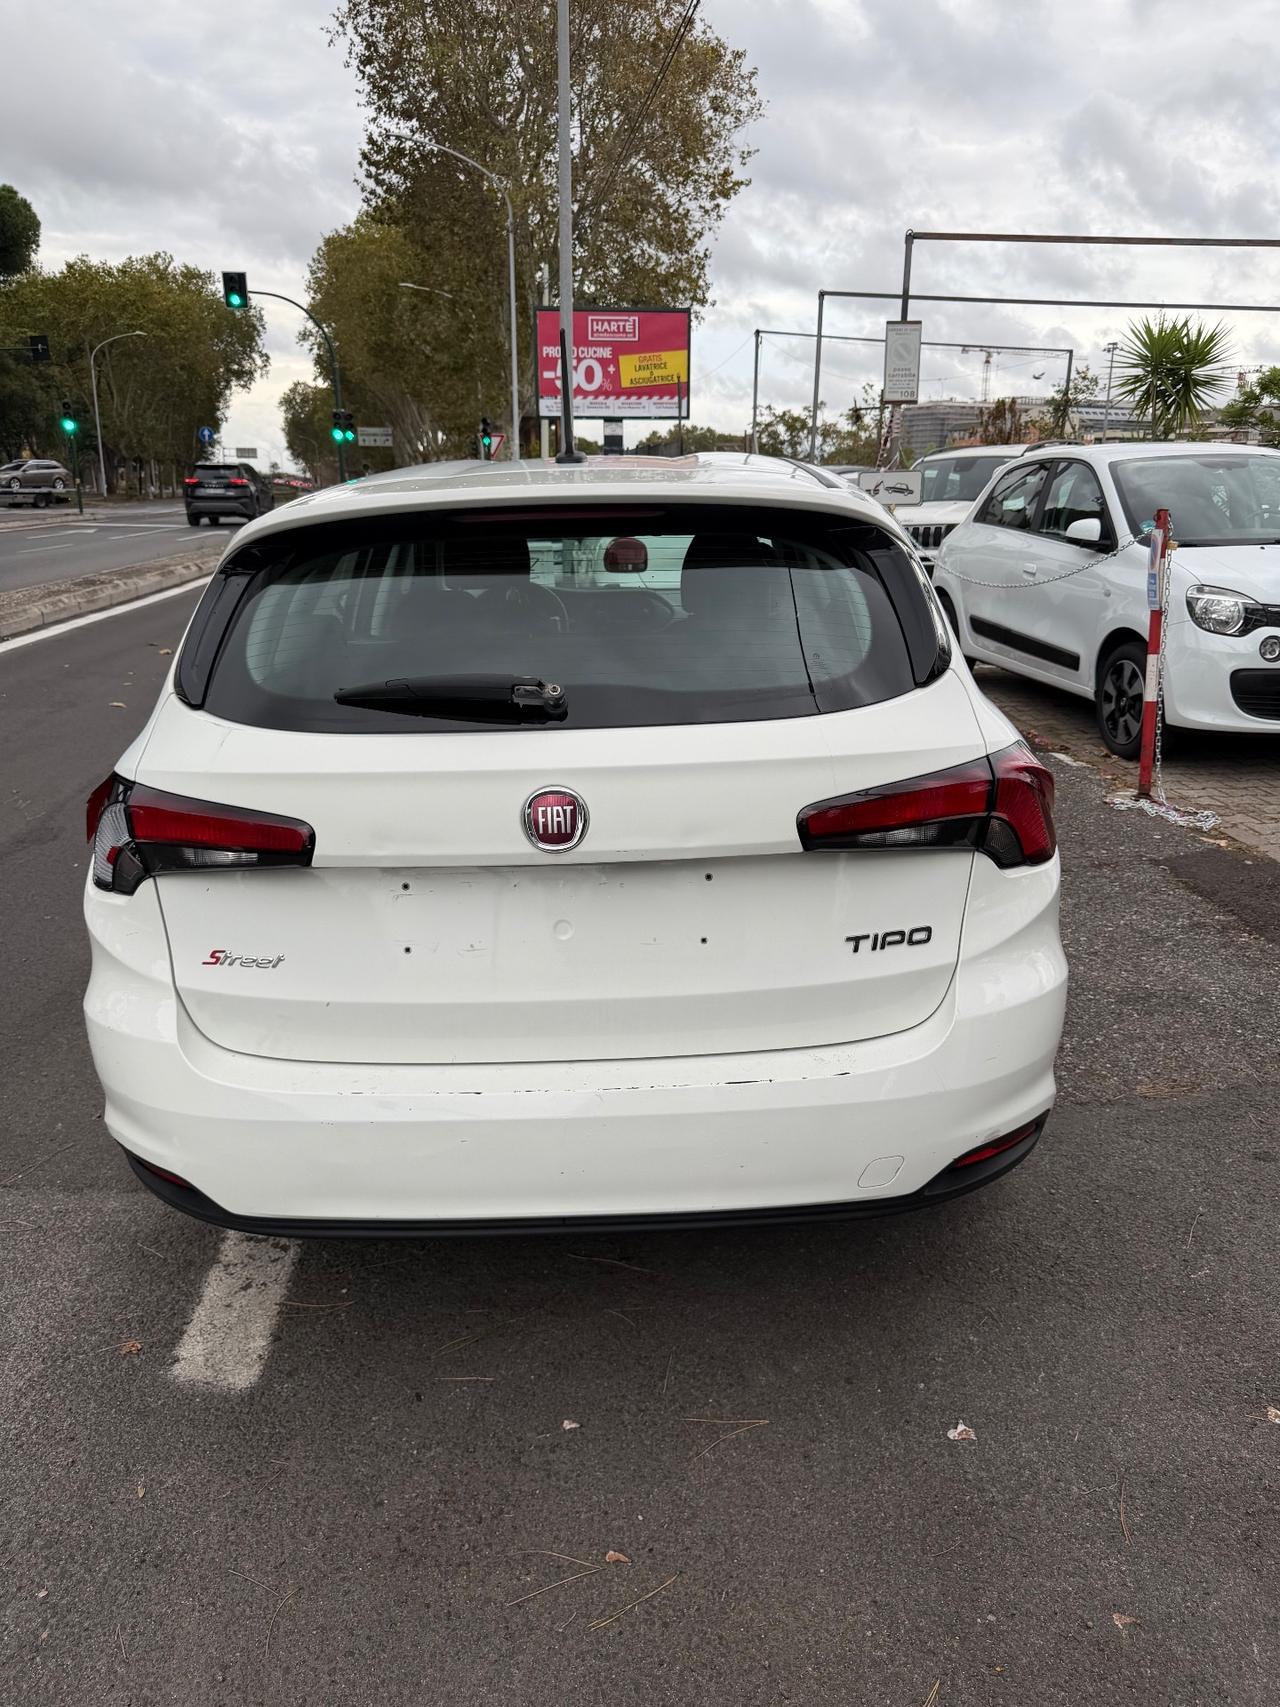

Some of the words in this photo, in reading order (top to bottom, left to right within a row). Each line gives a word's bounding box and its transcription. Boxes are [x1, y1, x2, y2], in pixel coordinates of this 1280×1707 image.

[543, 346, 578, 358] PROO
[578, 346, 613, 359] CUCINE
[638, 354, 663, 363] GRATIS
[634, 362, 668, 372] LAVATRICE
[629, 374, 675, 386] ASCIUGATRICE
[900, 390, 915, 398] 108
[538, 805, 574, 834] FIAT
[845, 925, 933, 953] TIPO
[202, 949, 286, 969] Street
